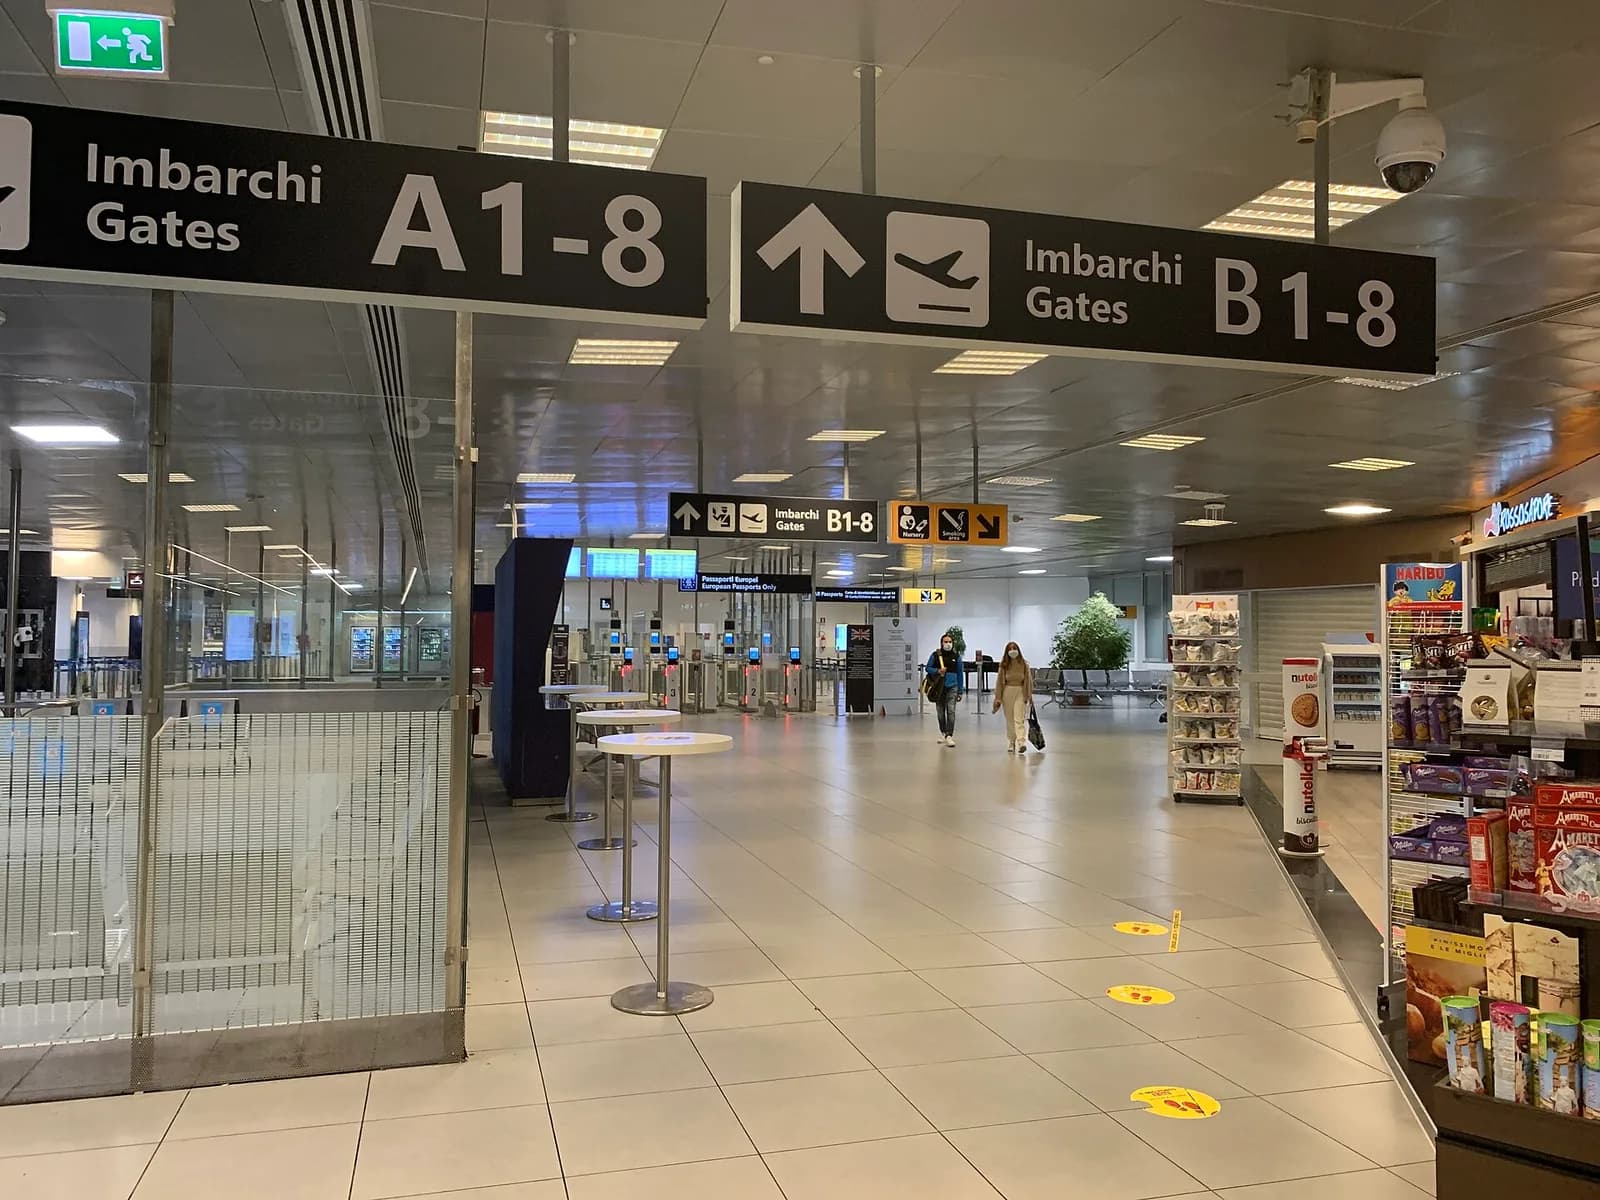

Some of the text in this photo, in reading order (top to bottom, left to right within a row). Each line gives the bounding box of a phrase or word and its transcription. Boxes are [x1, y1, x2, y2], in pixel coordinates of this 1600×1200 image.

[87, 143, 322, 205] Imbarchi
[86, 201, 241, 252] Gates
[1025, 239, 1183, 286] Imbarchi
[1026, 286, 1129, 326] Gates
[775, 509, 819, 521] Imbarchi
[776, 521, 805, 532] Gates
[827, 509, 874, 533] B1-8
[902, 531, 925, 539] Nursery
[942, 530, 966, 538] Smoking
[702, 576, 734, 584] Passaporti
[671, 689, 676, 697] 3
[751, 689, 756, 697] 2
[1300, 762, 1315, 814] nutella
[1439, 945, 1450, 953] LE
